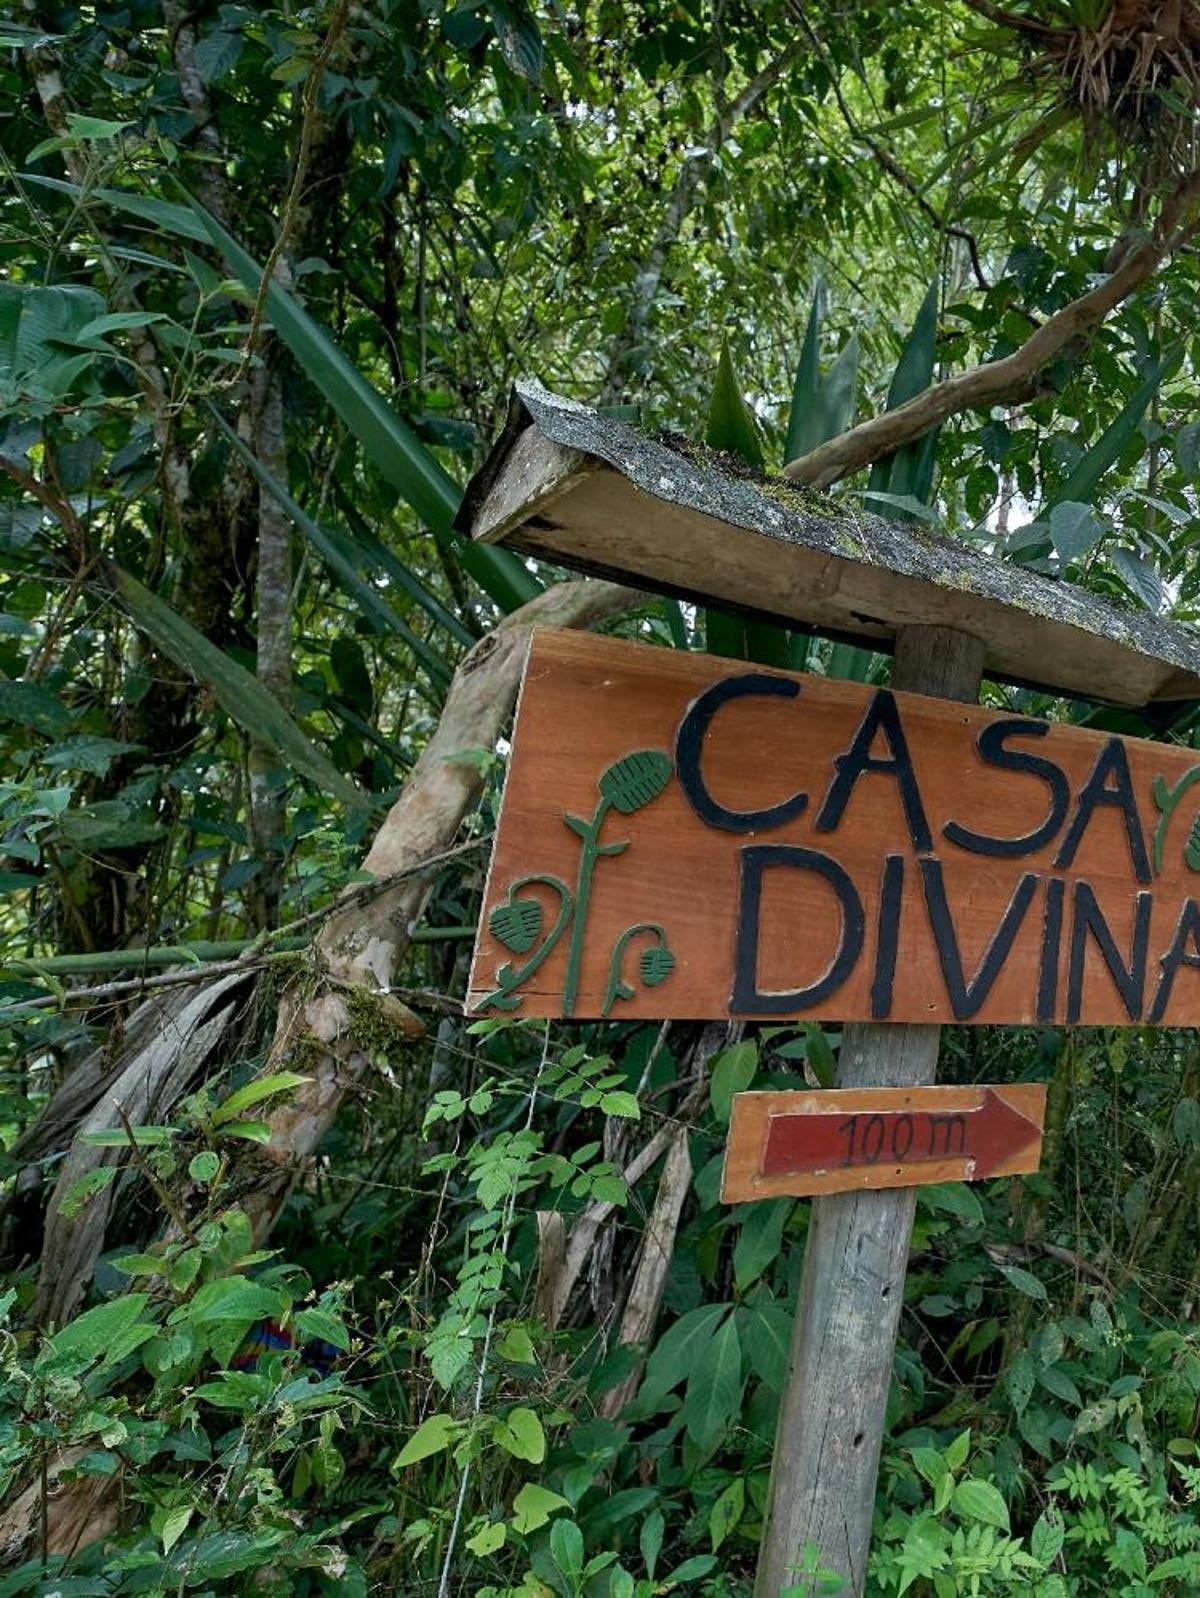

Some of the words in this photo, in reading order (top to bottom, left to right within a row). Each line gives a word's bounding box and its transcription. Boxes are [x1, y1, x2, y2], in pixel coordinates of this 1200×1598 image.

[676, 674, 1153, 883] CASA
[839, 1113, 912, 1163] 100
[929, 1113, 966, 1154] m
